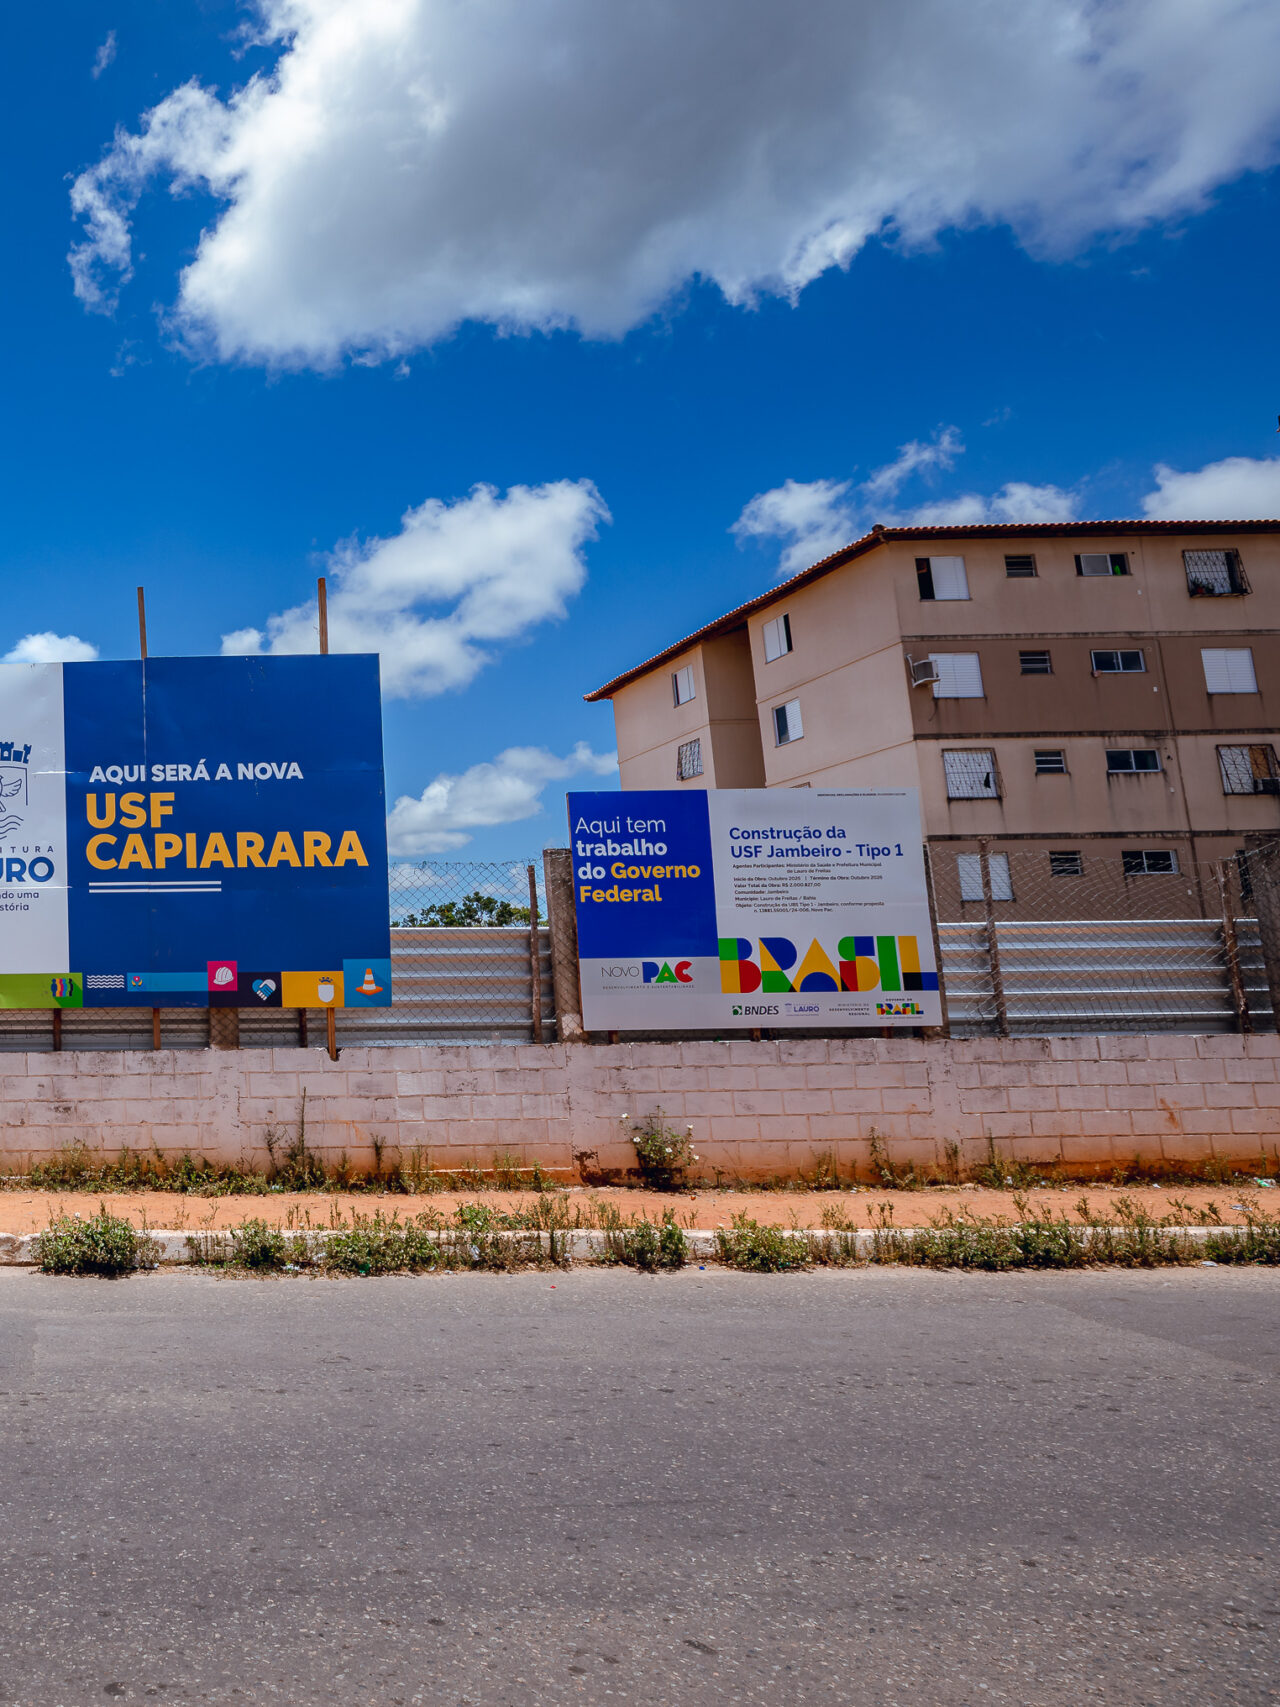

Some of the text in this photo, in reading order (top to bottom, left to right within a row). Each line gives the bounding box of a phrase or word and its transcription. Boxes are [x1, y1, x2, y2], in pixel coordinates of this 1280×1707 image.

[89, 759, 303, 785] AQUI SERÁ A NOVA
[86, 792, 175, 829] USF
[575, 817, 666, 838] Aqui tem
[729, 826, 846, 842] Construção da
[86, 830, 369, 870] CAPIARARA
[576, 839, 668, 856] trabalho
[731, 845, 762, 858] USF
[767, 844, 843, 858] Jambeiro
[856, 844, 891, 861] Tipo
[895, 843, 903, 856] 1
[578, 862, 701, 880] do Governo
[17, 891, 39, 900] uma
[580, 885, 662, 902] Federal
[601, 961, 693, 983] NOVO PAC
[718, 936, 939, 993] BRASIL
[745, 1006, 779, 1015] BNDES
[876, 1003, 924, 1015] BRASIL
